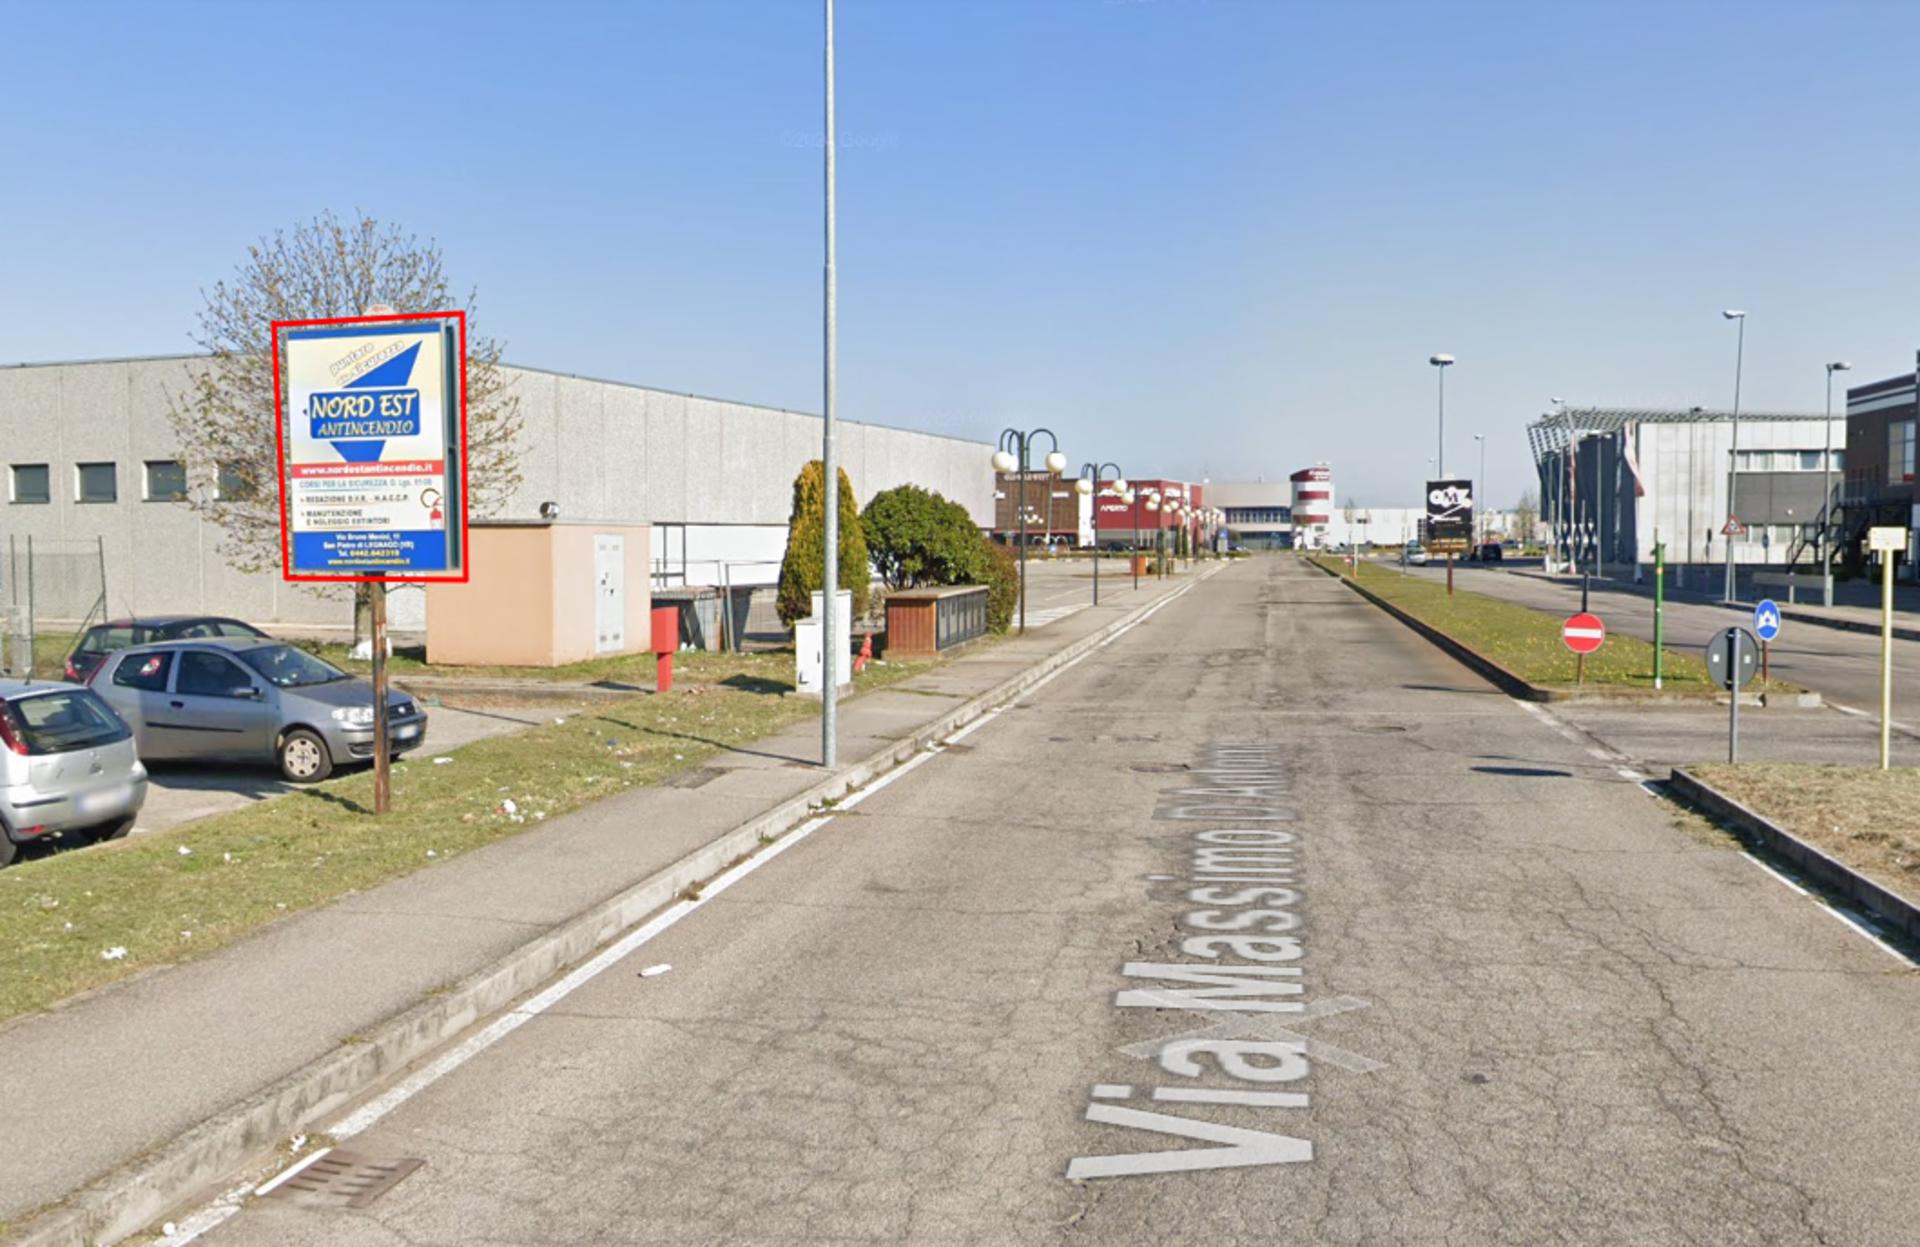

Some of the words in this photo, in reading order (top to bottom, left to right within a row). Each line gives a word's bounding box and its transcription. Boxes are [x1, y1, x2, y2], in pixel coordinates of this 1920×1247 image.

[312, 394, 375, 419] NORD
[380, 391, 417, 416] EST
[317, 419, 414, 436] ANTINCENDIO
[322, 479, 337, 487] PER
[338, 478, 347, 487] LA
[306, 495, 346, 503] REDAZIONE
[306, 508, 363, 517] MANUTENZIONE
[313, 517, 350, 526] NOLEGGIO
[351, 516, 390, 525] ESTINTORI
